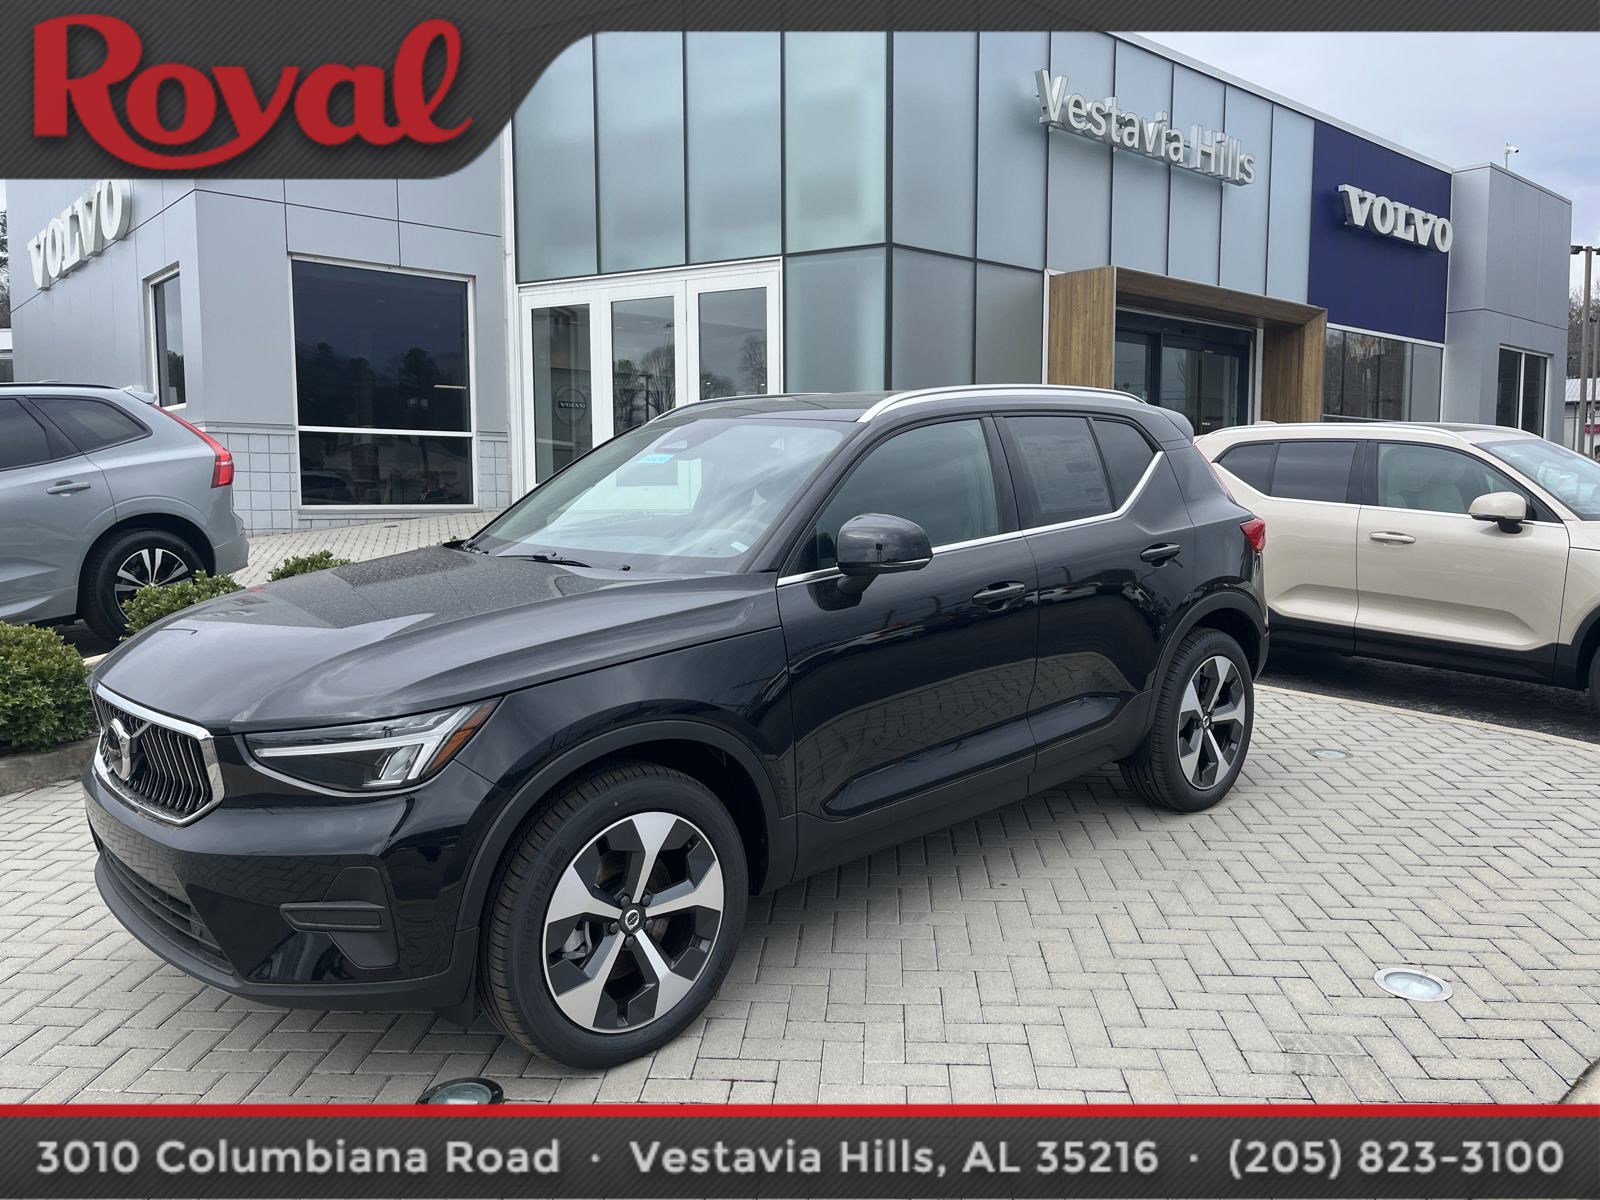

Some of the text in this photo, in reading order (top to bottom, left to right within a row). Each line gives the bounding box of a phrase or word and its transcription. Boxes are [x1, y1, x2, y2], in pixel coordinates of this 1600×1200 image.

[1035, 68, 1256, 186] Vestavia Hills
[27, 179, 132, 291] VOLVO
[1337, 183, 1454, 253] VOLVO
[560, 401, 586, 409] VOLVO
